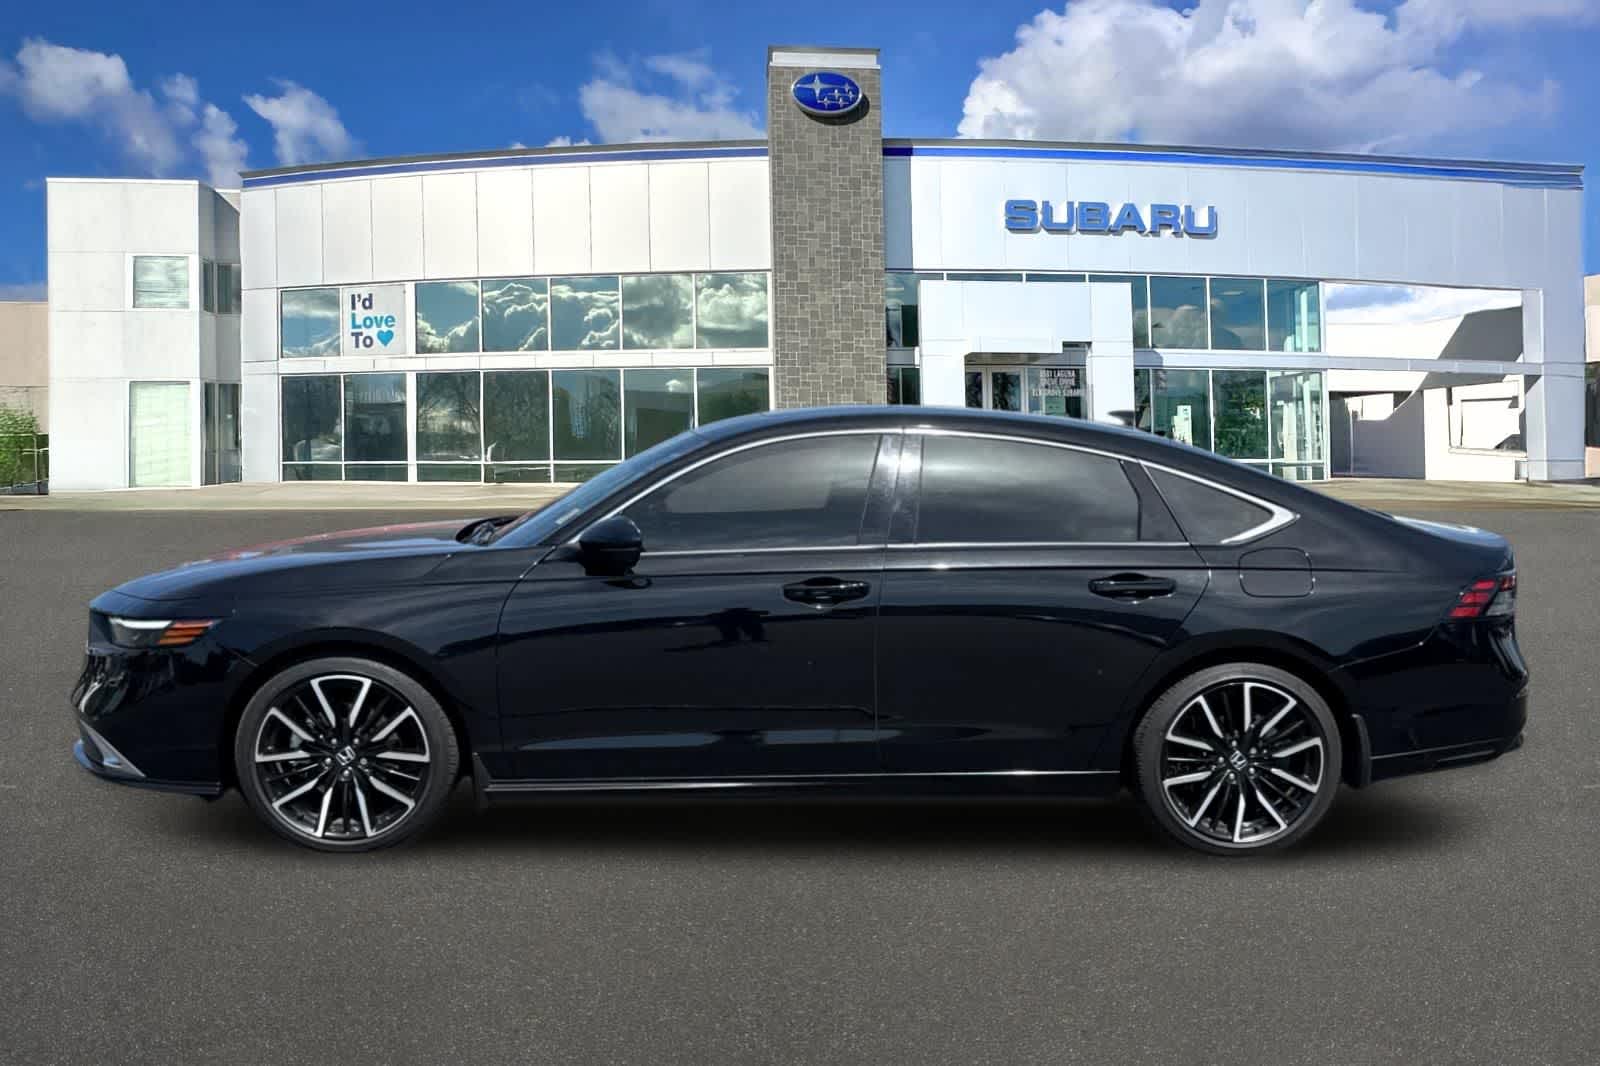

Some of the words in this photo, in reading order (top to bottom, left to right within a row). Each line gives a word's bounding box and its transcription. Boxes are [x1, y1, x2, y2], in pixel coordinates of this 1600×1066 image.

[1005, 199, 1217, 238] SUBARU
[351, 313, 396, 329] Love
[351, 331, 374, 348] To
